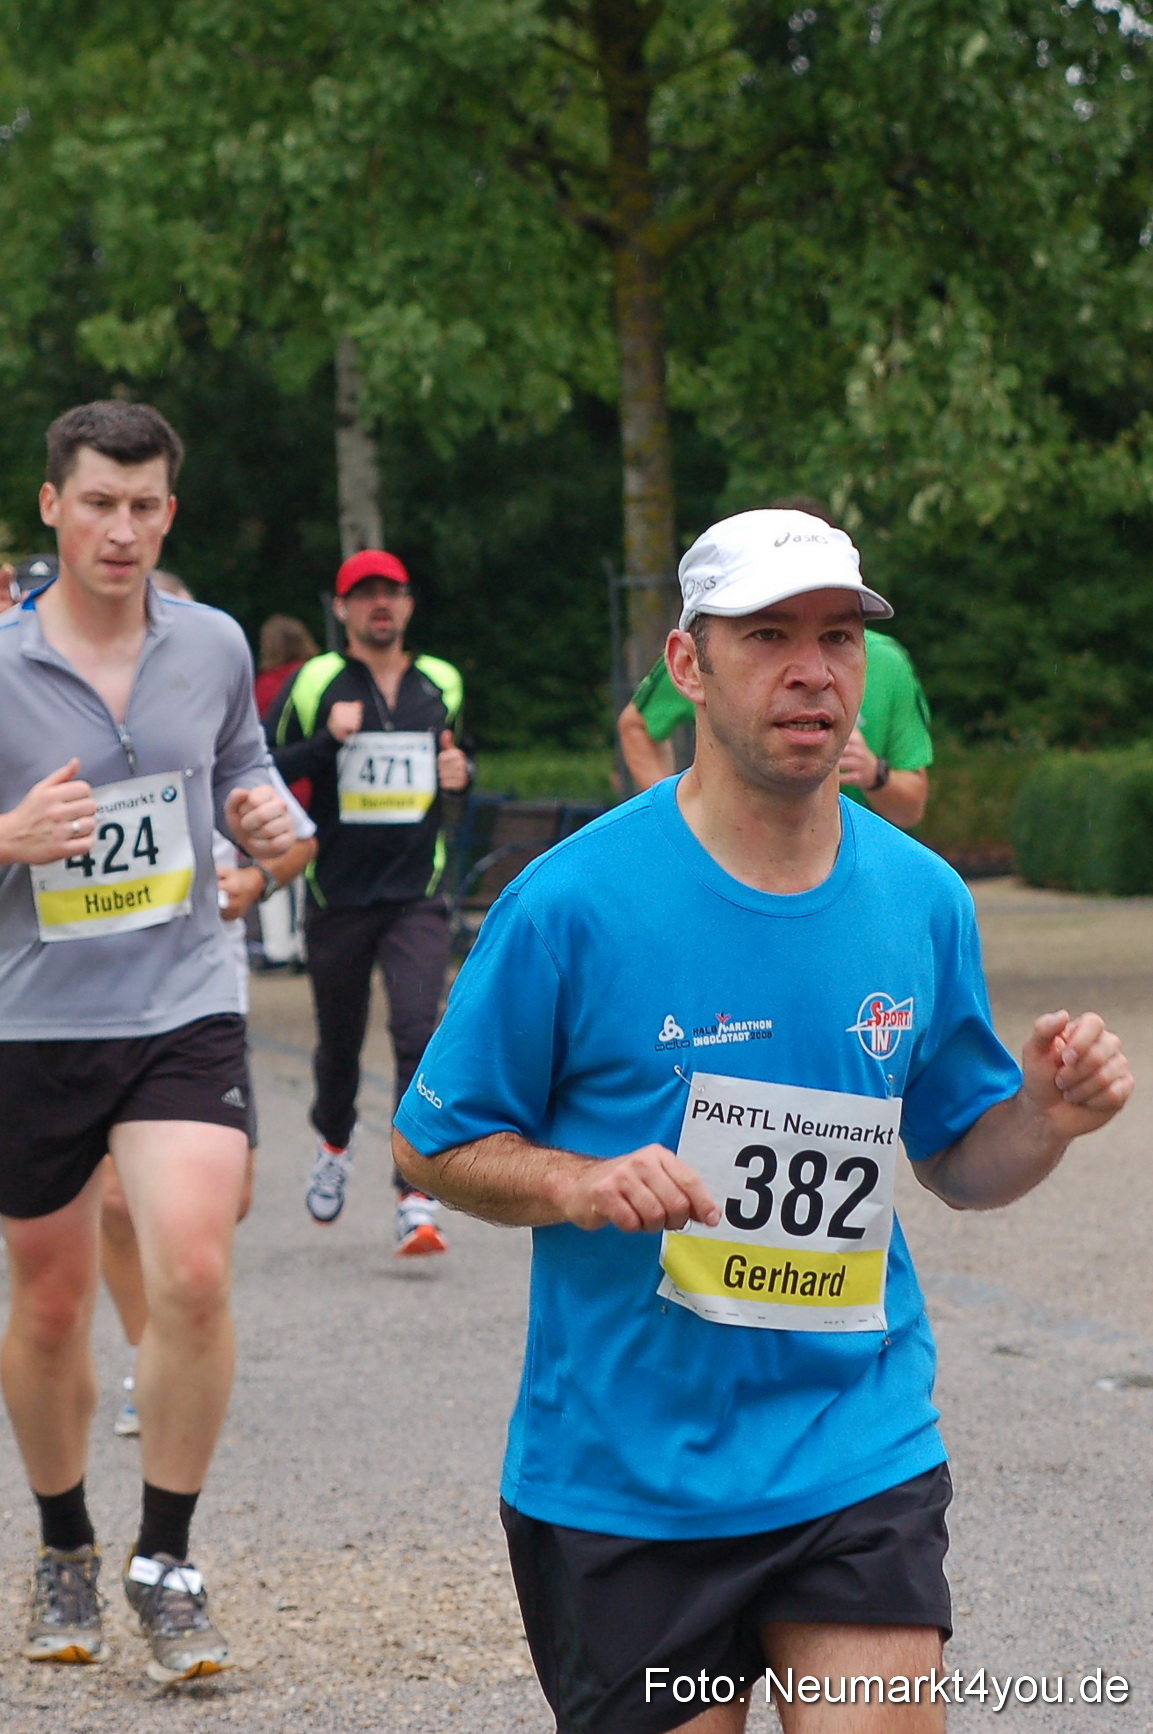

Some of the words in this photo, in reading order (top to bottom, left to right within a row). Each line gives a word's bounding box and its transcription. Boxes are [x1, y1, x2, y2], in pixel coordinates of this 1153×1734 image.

[360, 756, 413, 784] 471
[96, 793, 155, 814] eumarkt
[85, 886, 151, 914] Hubert
[654, 1039, 691, 1051] odlo
[691, 1099, 776, 1131] PARTL
[783, 1112, 894, 1145] Neumarkt
[725, 1144, 879, 1239] 382
[723, 1254, 846, 1297] Gerhard
